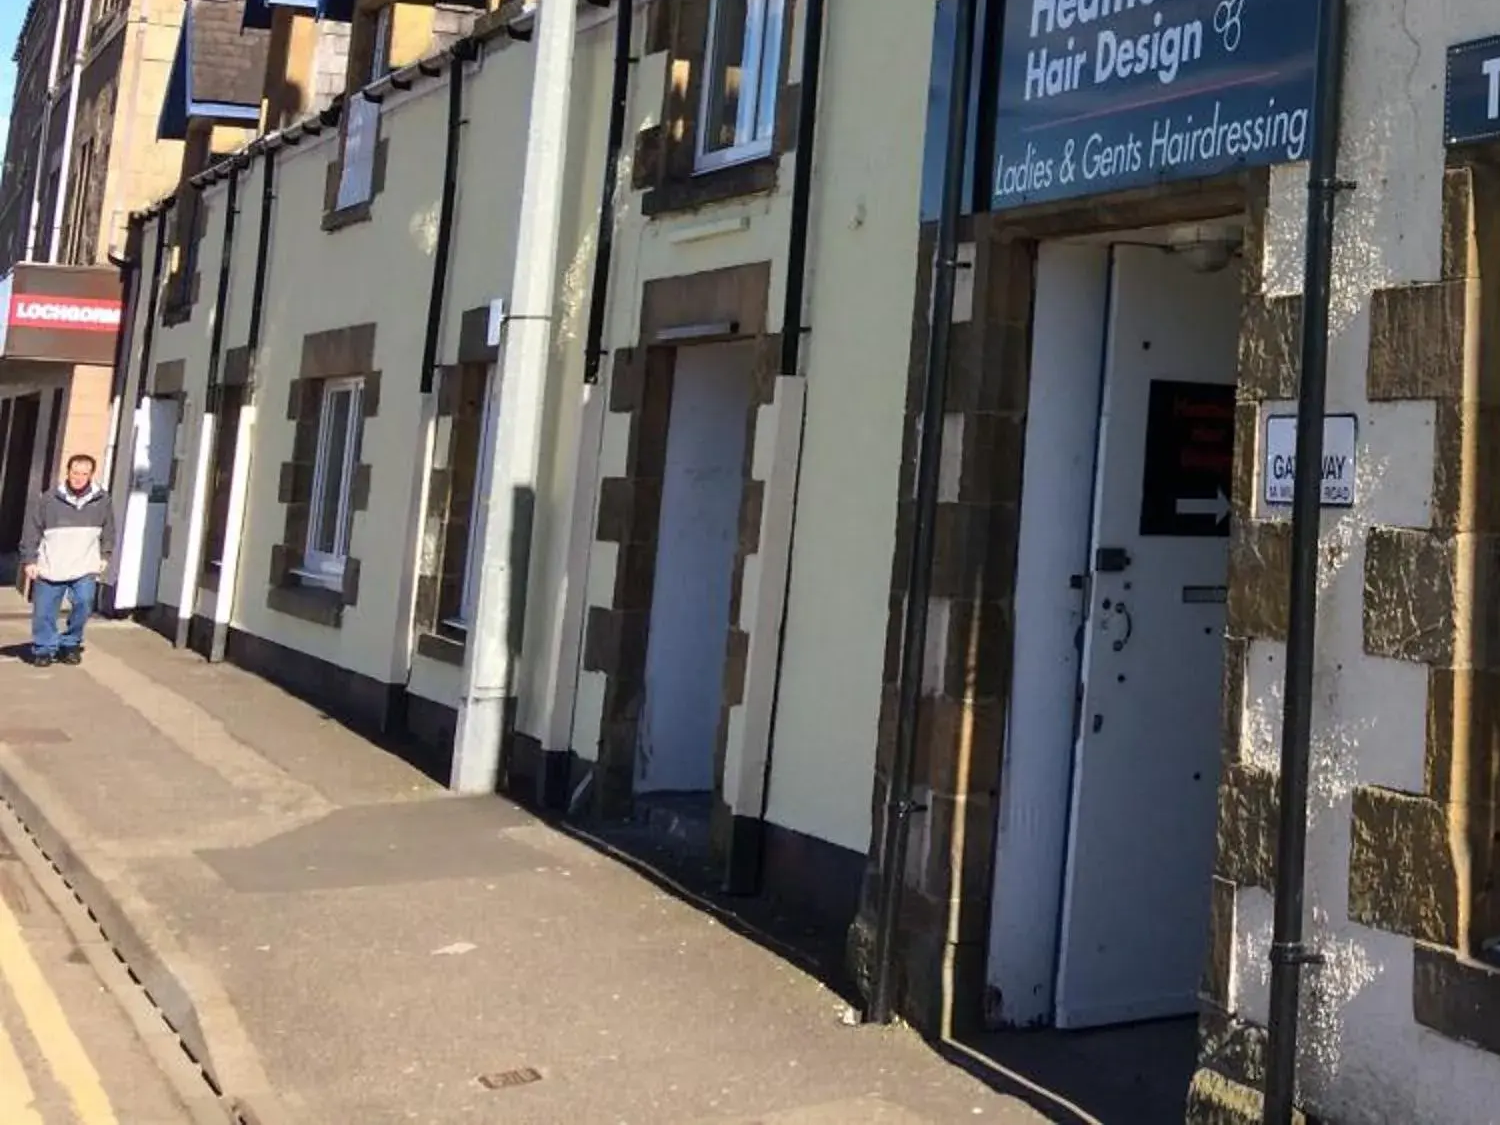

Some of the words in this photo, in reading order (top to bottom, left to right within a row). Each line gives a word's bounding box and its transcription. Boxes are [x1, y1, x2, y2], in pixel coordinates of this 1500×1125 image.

[1023, 36, 1087, 101] Hair
[1093, 11, 1203, 84] Design
[994, 142, 1053, 196] Ladies
[1059, 138, 1076, 184] &
[1081, 132, 1143, 179] Gents
[1149, 97, 1309, 169] Hairdressing
